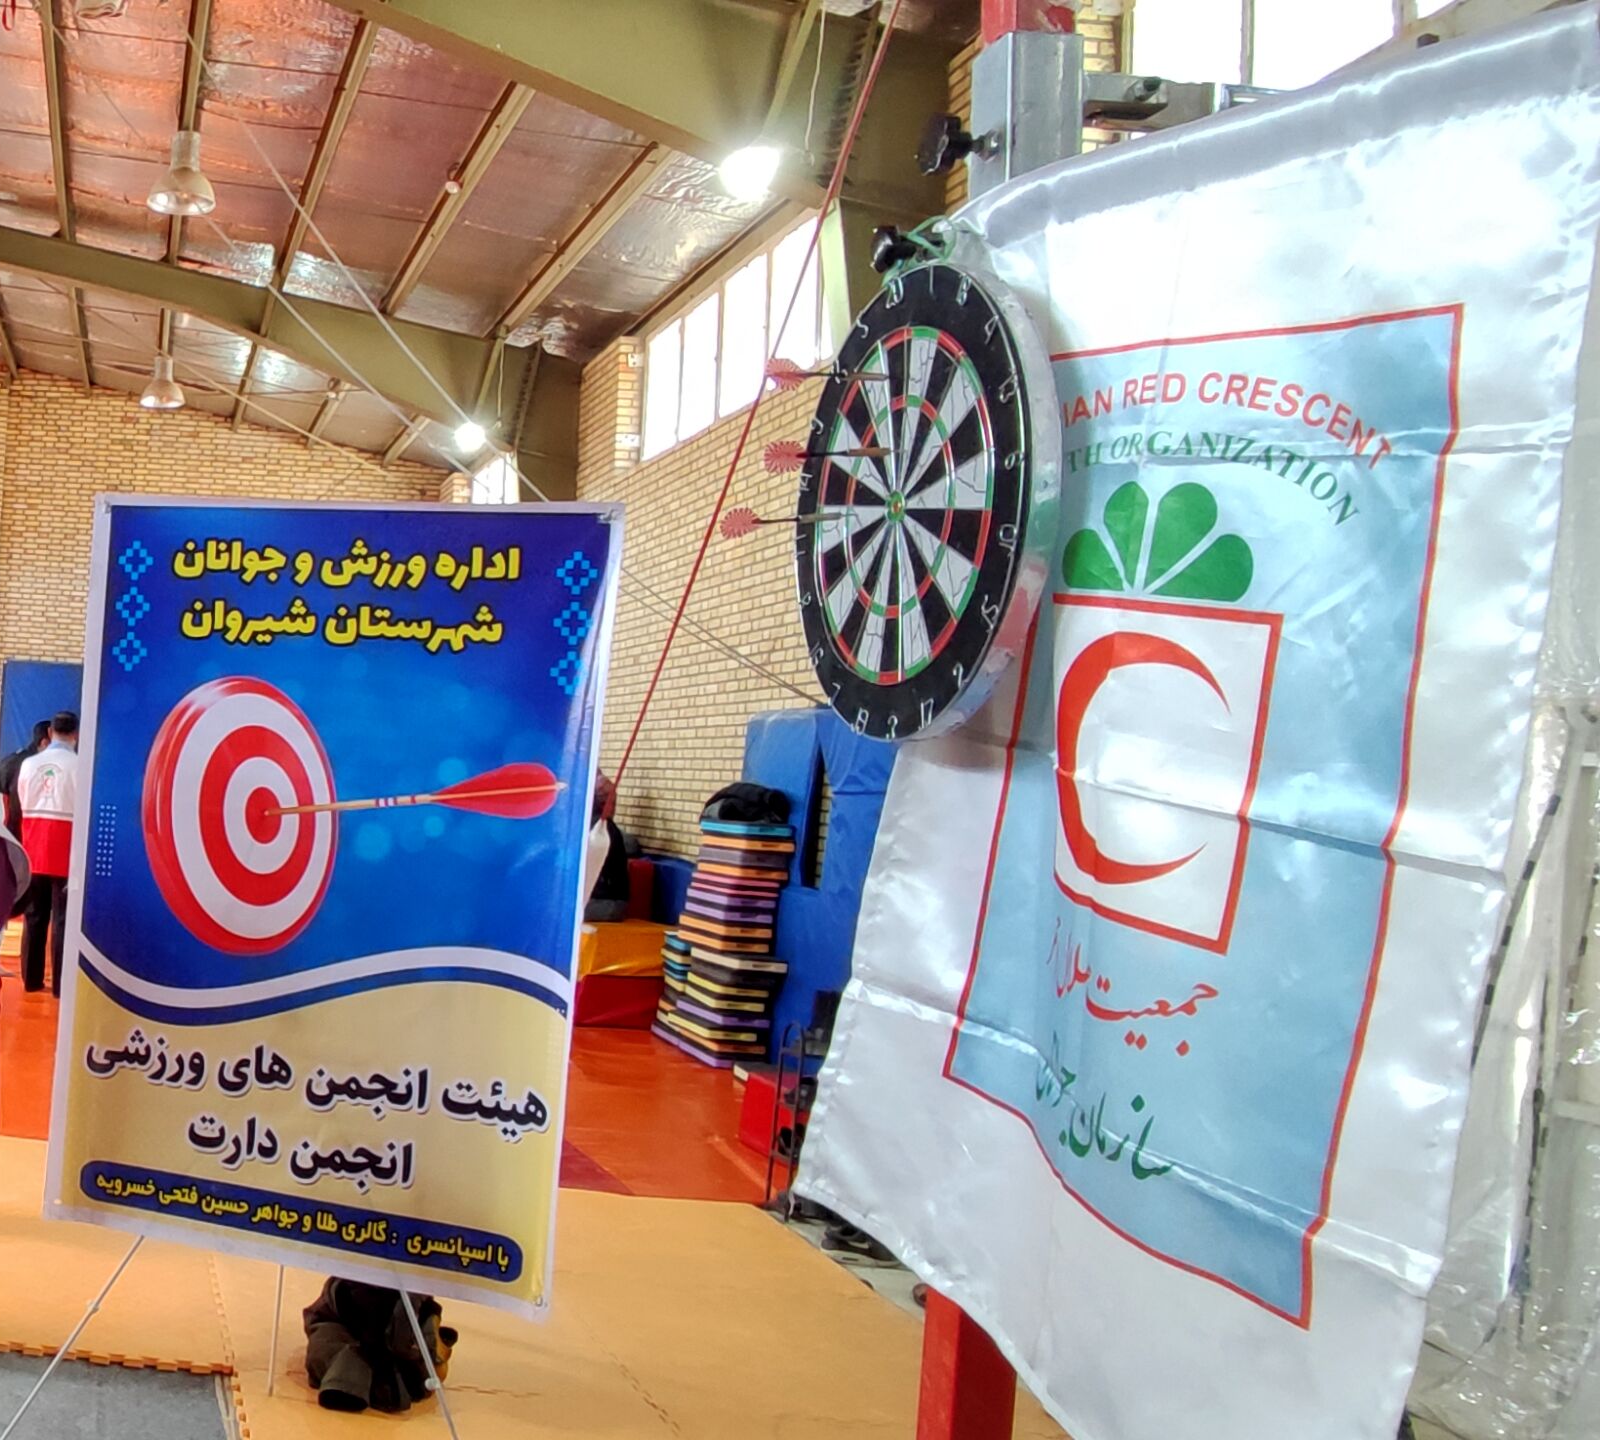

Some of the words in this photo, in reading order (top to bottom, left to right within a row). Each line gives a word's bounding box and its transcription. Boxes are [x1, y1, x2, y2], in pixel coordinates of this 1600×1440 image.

[1122, 372, 1187, 410] RED
[1197, 371, 1393, 470] CRESCENT
[1110, 430, 1361, 527] ORGANIZATION
[172, 539, 287, 584] جوانان
[294, 550, 314, 585] و
[319, 539, 427, 589] ورزش
[433, 546, 521, 592] اداره
[180, 598, 317, 644] شیروان
[323, 604, 504, 654] شهرستان
[1084, 974, 1220, 1058] جمعیت
[85, 1028, 206, 1087] ورزشی
[216, 1044, 294, 1093] های
[304, 1067, 430, 1116] انجمن
[440, 1079, 549, 1139] هیئت
[187, 1114, 279, 1166] دارت
[95, 1173, 157, 1197] خسرویه
[289, 1139, 414, 1190] انجمن
[157, 1185, 199, 1206] فتحی
[200, 1194, 250, 1216] حسین
[251, 1203, 299, 1230] جواهر
[300, 1214, 312, 1233] و
[315, 1210, 339, 1234] طلا
[341, 1220, 389, 1244] گالری
[405, 1233, 494, 1268] اسپانسری
[496, 1245, 510, 1273] با
